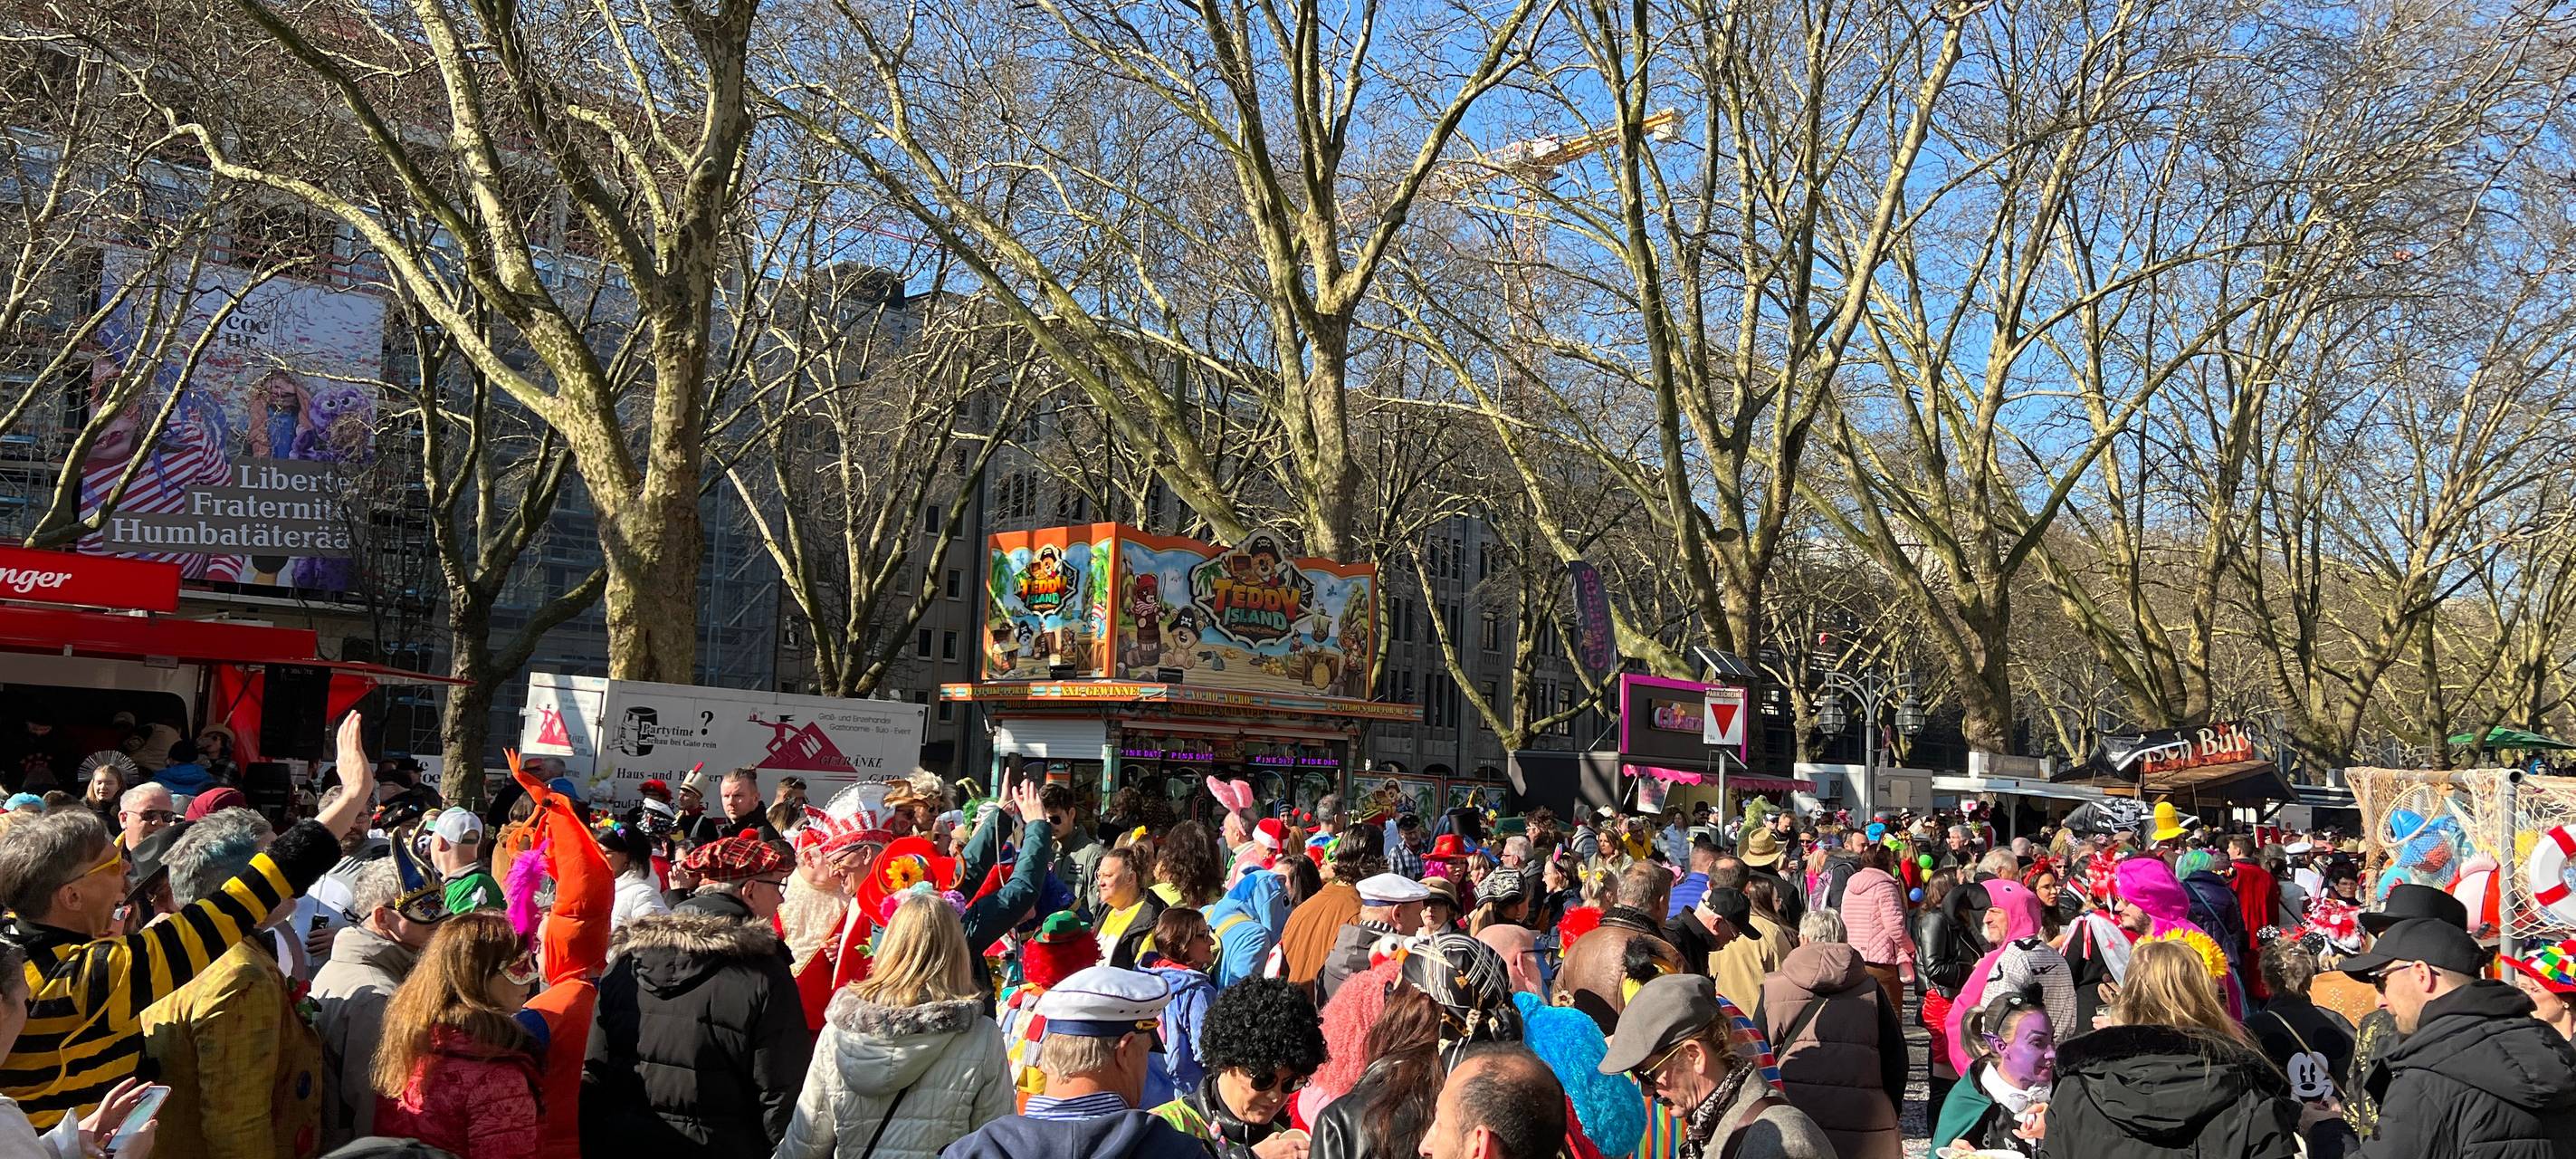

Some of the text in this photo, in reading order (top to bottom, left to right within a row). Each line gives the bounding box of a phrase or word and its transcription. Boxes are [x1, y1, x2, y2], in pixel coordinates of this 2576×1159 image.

[226, 316, 269, 334] coe
[1020, 575, 1067, 599] TEDDY
[1026, 592, 1060, 606] ISLAND
[1213, 579, 1301, 621] TEDDY
[1225, 606, 1287, 631] ISLAND
[1061, 685, 1141, 697] XXL-GEWINNE!
[643, 723, 694, 737] Partytime
[701, 741, 717, 749] rein
[616, 767, 644, 779] Haus
